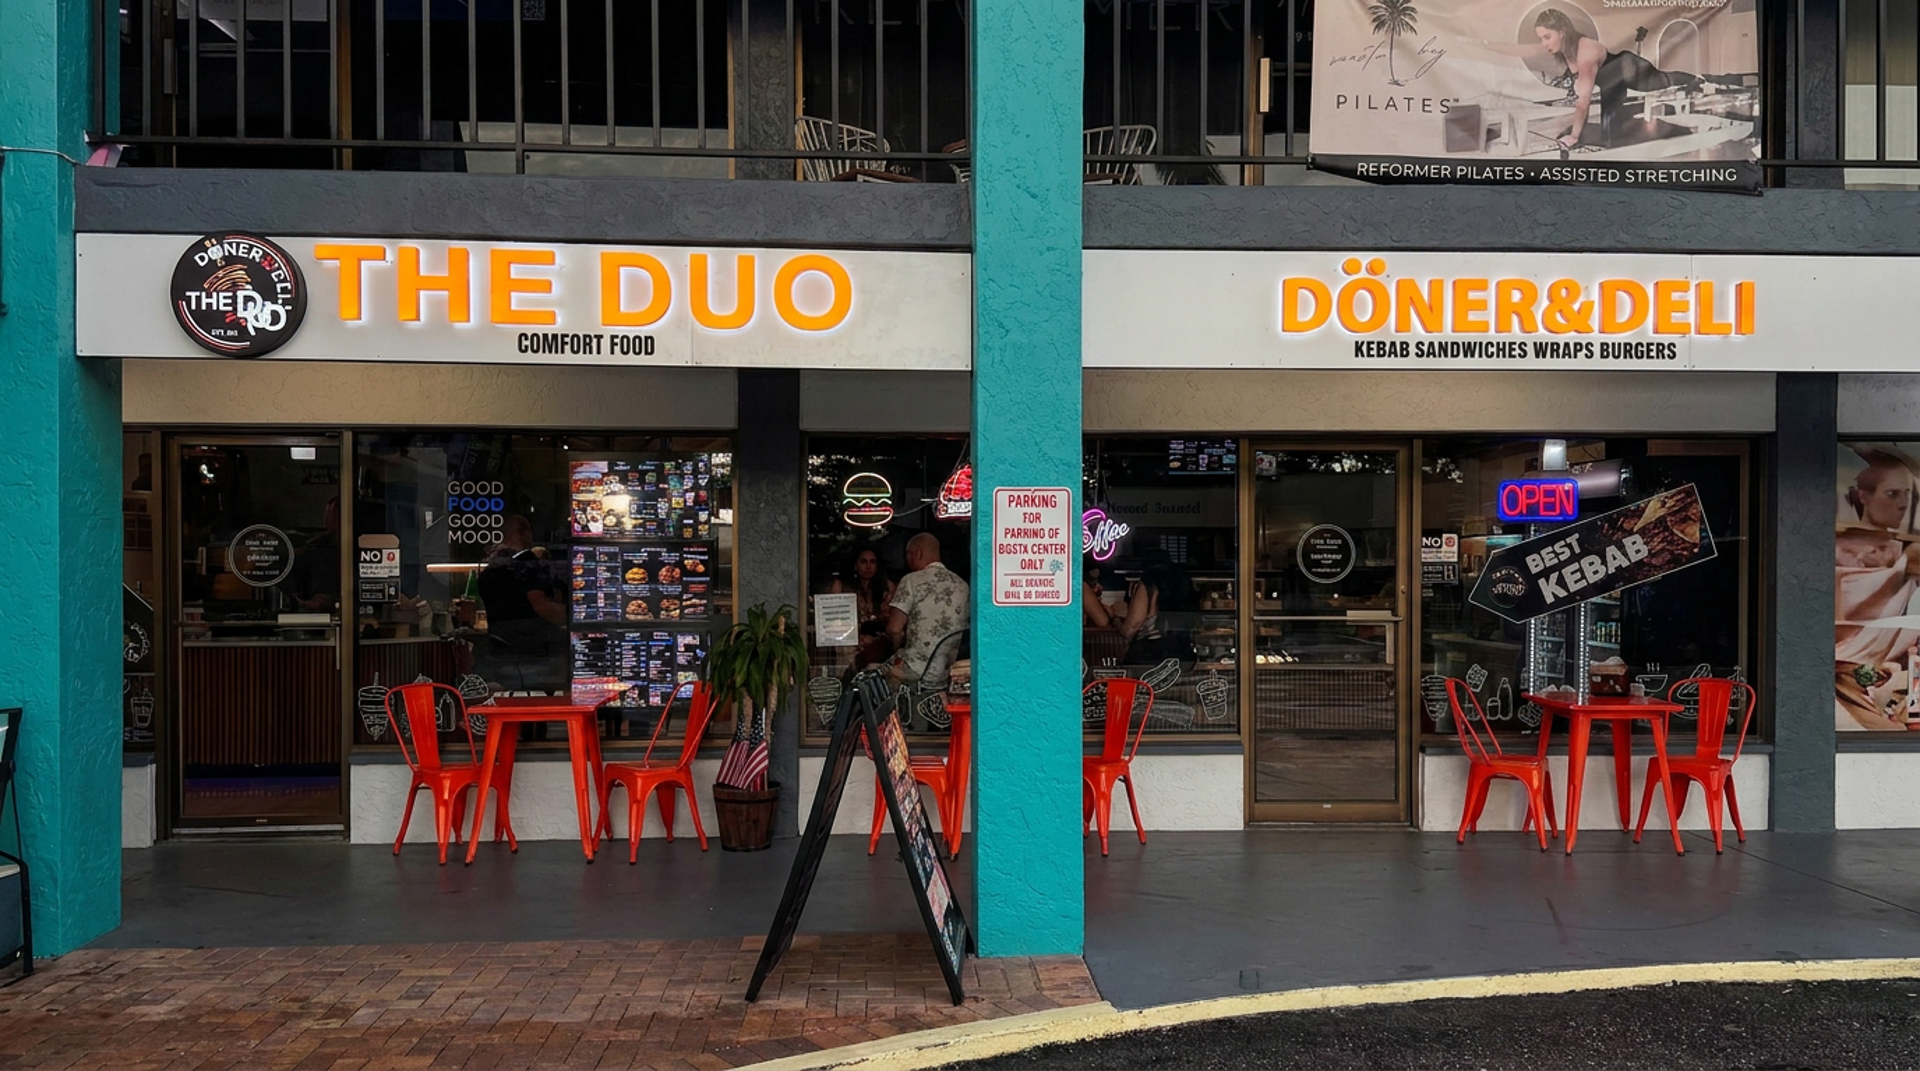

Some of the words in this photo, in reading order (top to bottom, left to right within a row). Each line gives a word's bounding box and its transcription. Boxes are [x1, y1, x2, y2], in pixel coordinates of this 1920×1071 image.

[1357, 162, 1451, 179] REFORMER
[1456, 166, 1525, 181] PILATES
[1540, 168, 1620, 182] ASSISTED
[1625, 168, 1737, 183] STRETCHING
[314, 244, 557, 325] THE
[600, 251, 853, 331] DUO
[185, 291, 233, 311] THE
[1281, 257, 1756, 336] DÖNER&DELI
[517, 332, 604, 355] COMFORT
[610, 335, 655, 356] FOOD
[1354, 340, 1410, 359] KEBAB
[1414, 341, 1528, 360] SANDWICHES
[1533, 342, 1594, 360] WRAPS
[1600, 342, 1677, 360] BURGERS
[447, 481, 504, 495] GOOD
[448, 497, 504, 512] FOOD
[1008, 494, 1057, 508] PARKING
[1502, 484, 1574, 516] OPEN
[448, 514, 504, 527] GOOD
[1022, 512, 1042, 524] FOR
[448, 530, 504, 544] MOOD
[1048, 528, 1060, 539] OF
[1031, 543, 1067, 555] CENTER
[1422, 537, 1441, 547] NO
[360, 550, 381, 562] NO
[1525, 533, 1581, 575] BEST
[1537, 534, 1649, 605] KEBAB
